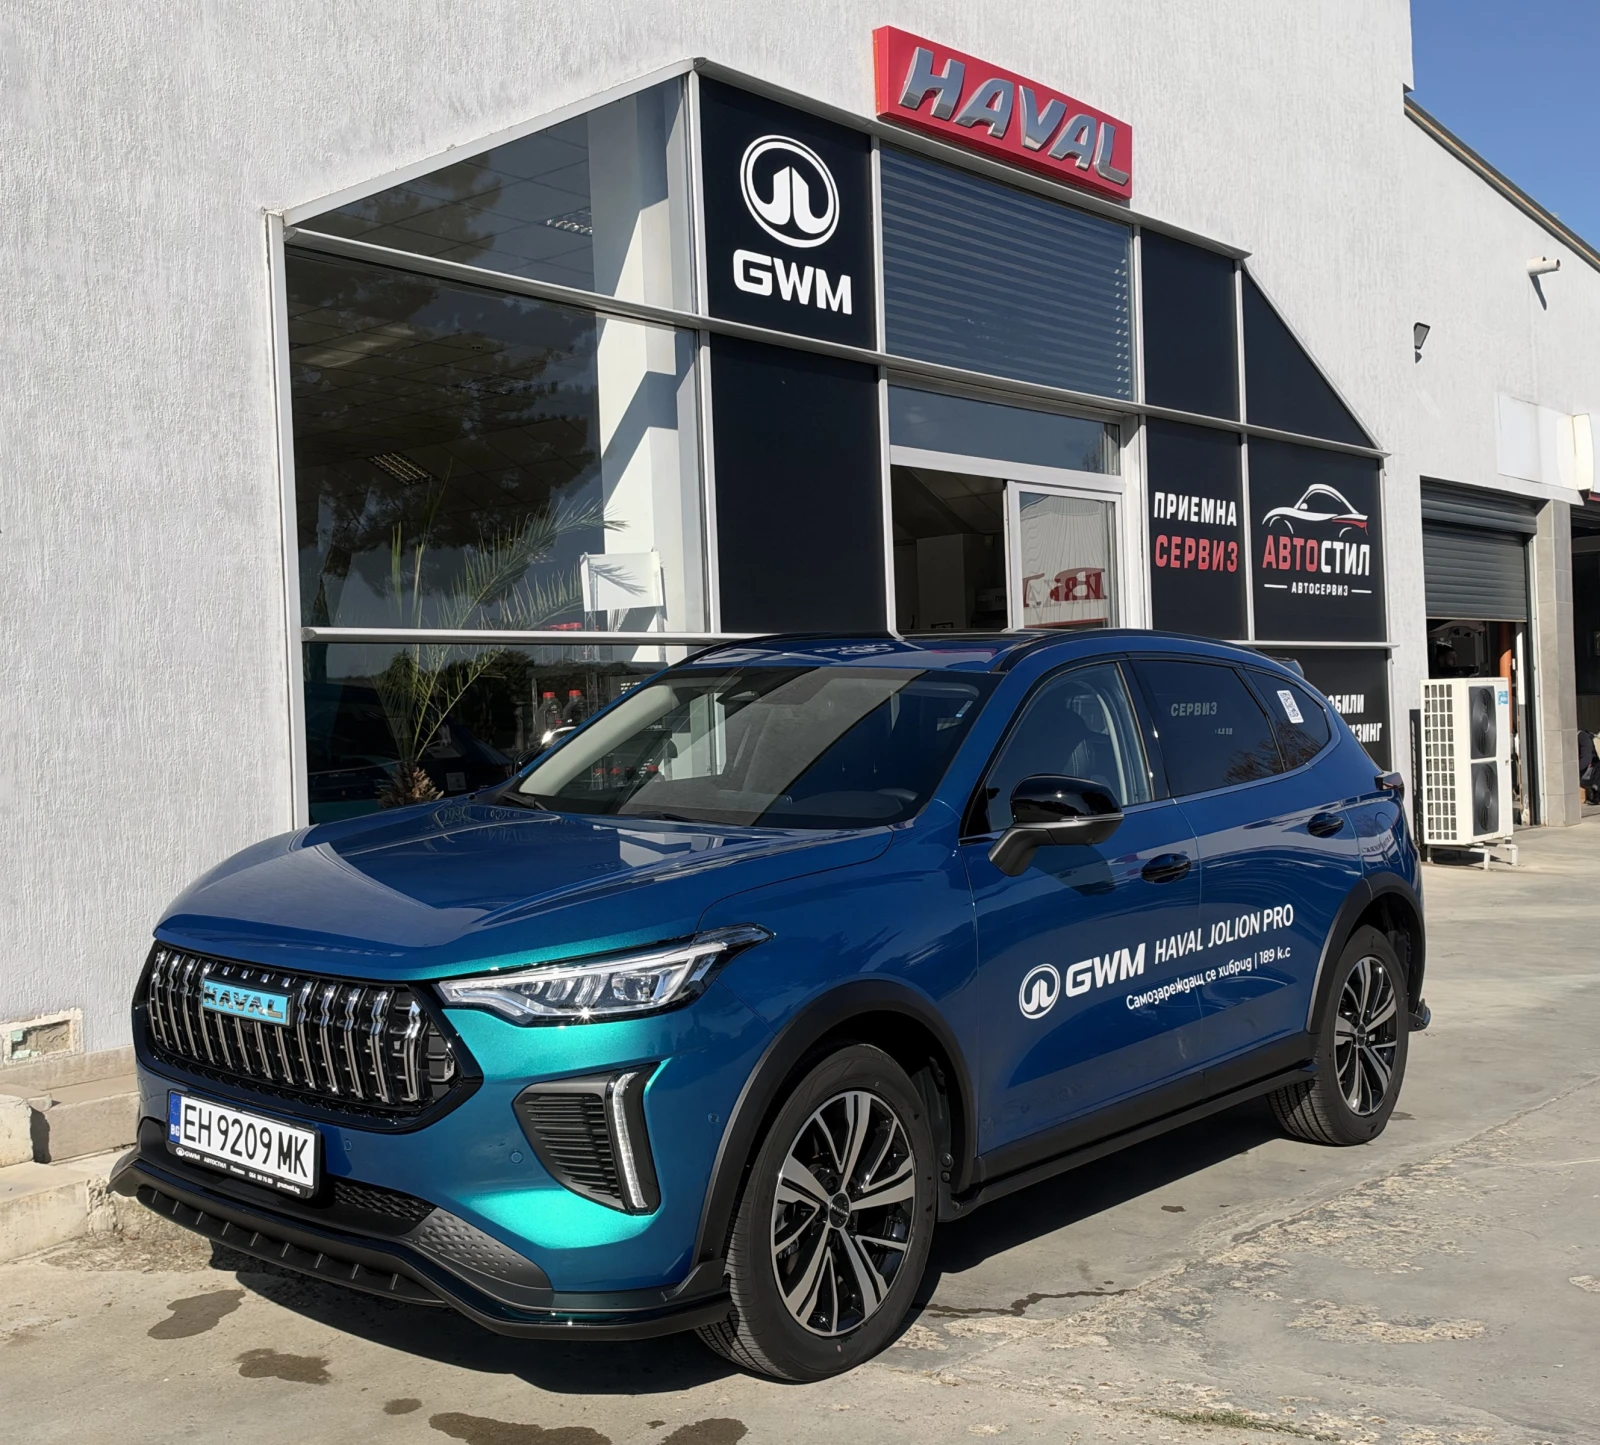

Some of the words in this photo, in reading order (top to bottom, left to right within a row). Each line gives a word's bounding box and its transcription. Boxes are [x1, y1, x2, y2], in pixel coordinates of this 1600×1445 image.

[898, 46, 1130, 186] HAVAL
[732, 248, 853, 316] GWM
[1153, 491, 1237, 527] ПРИЕМНА
[1154, 534, 1239, 573] СЕРВИЗ
[1261, 534, 1371, 577] АВТОСТИЛ
[1291, 581, 1349, 596] АВТОСЕРВИЗ
[1170, 701, 1218, 717] СЕРВИЗ
[1325, 694, 1365, 714] ОБИЛИ
[1065, 942, 1146, 998] GWM
[1154, 928, 1204, 965] HAVAL
[1208, 911, 1261, 948] JOLION
[1263, 903, 1294, 933] PRO
[1126, 974, 1205, 1010] Самозареждащ
[1205, 967, 1217, 981] се
[1218, 956, 1252, 979] хибрид
[1259, 949, 1275, 965] 189
[203, 984, 283, 1019] HAVAL
[170, 1123, 180, 1137] BG
